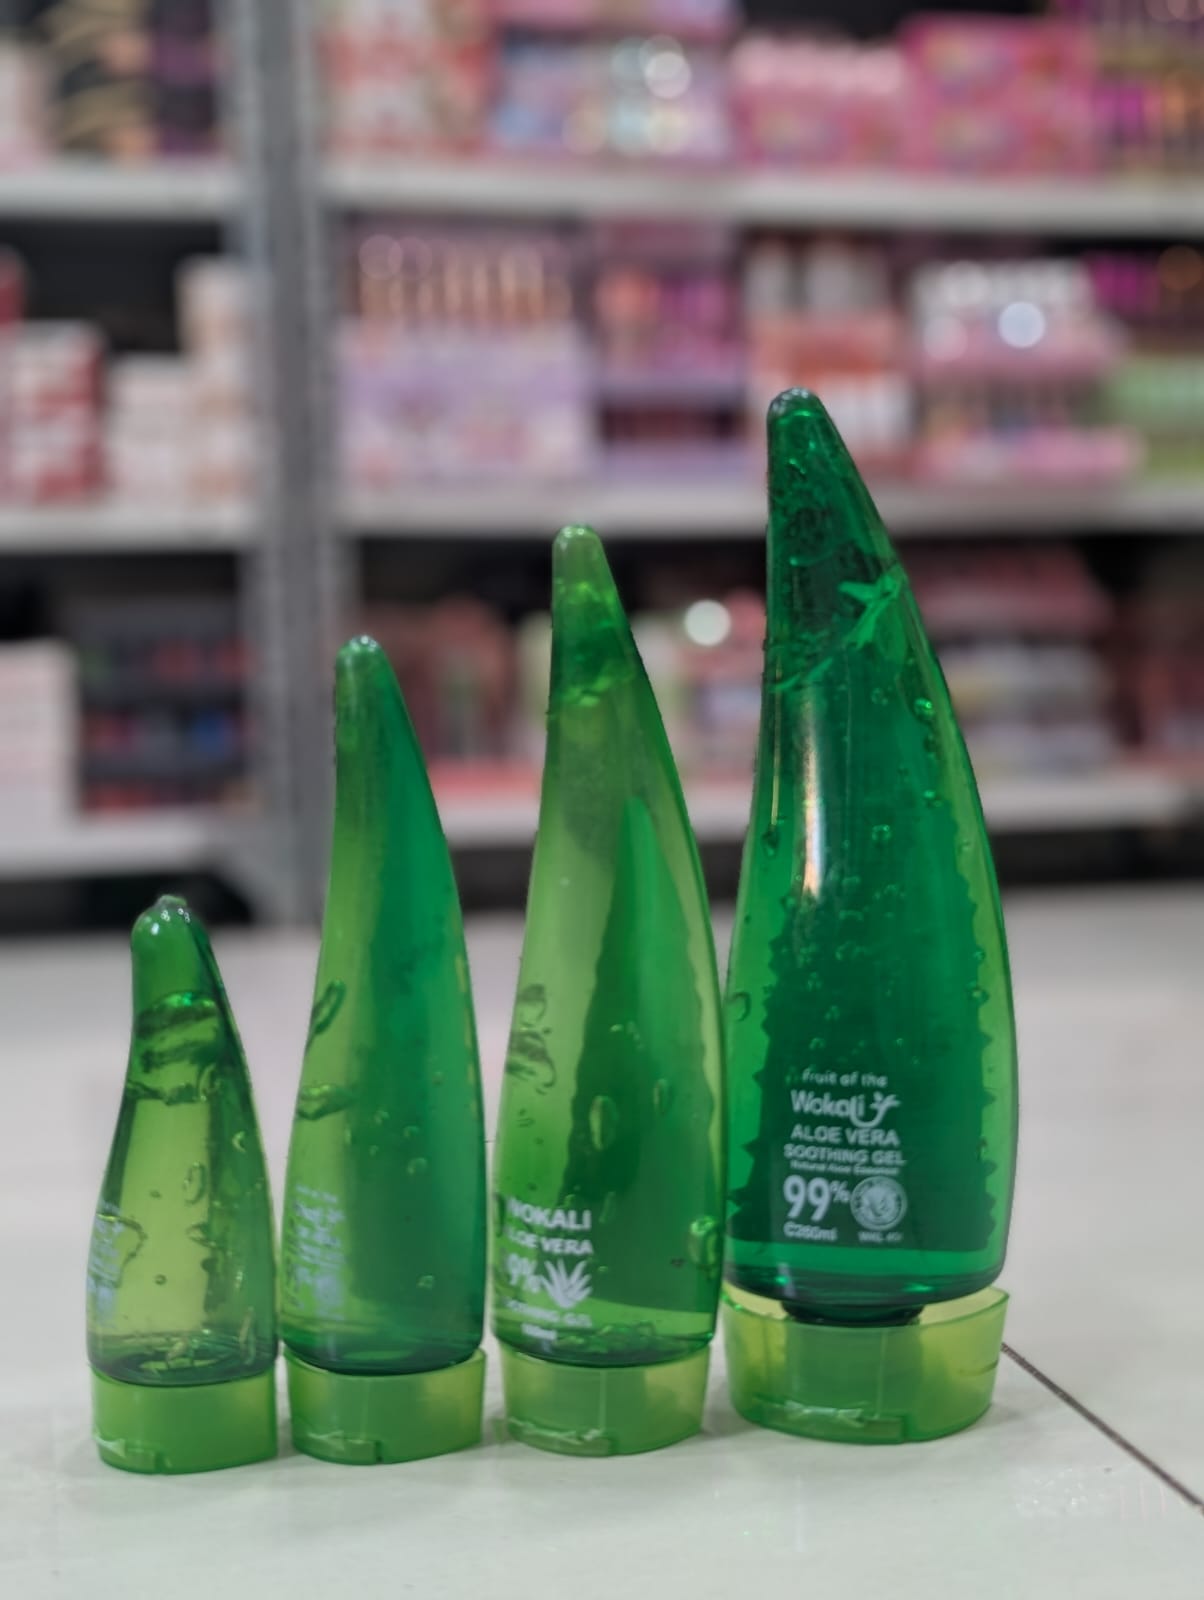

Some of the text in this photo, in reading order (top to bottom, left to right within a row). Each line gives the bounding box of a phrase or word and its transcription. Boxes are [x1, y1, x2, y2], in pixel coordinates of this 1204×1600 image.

[839, 1071, 859, 1087] of
[790, 1089, 889, 1128] Wokali
[790, 1124, 901, 1148] ALOE VERA
[783, 1143, 907, 1167] SOOTHING GEL
[783, 1174, 850, 1221] 99%
[505, 1225, 594, 1256] LOE VERA
